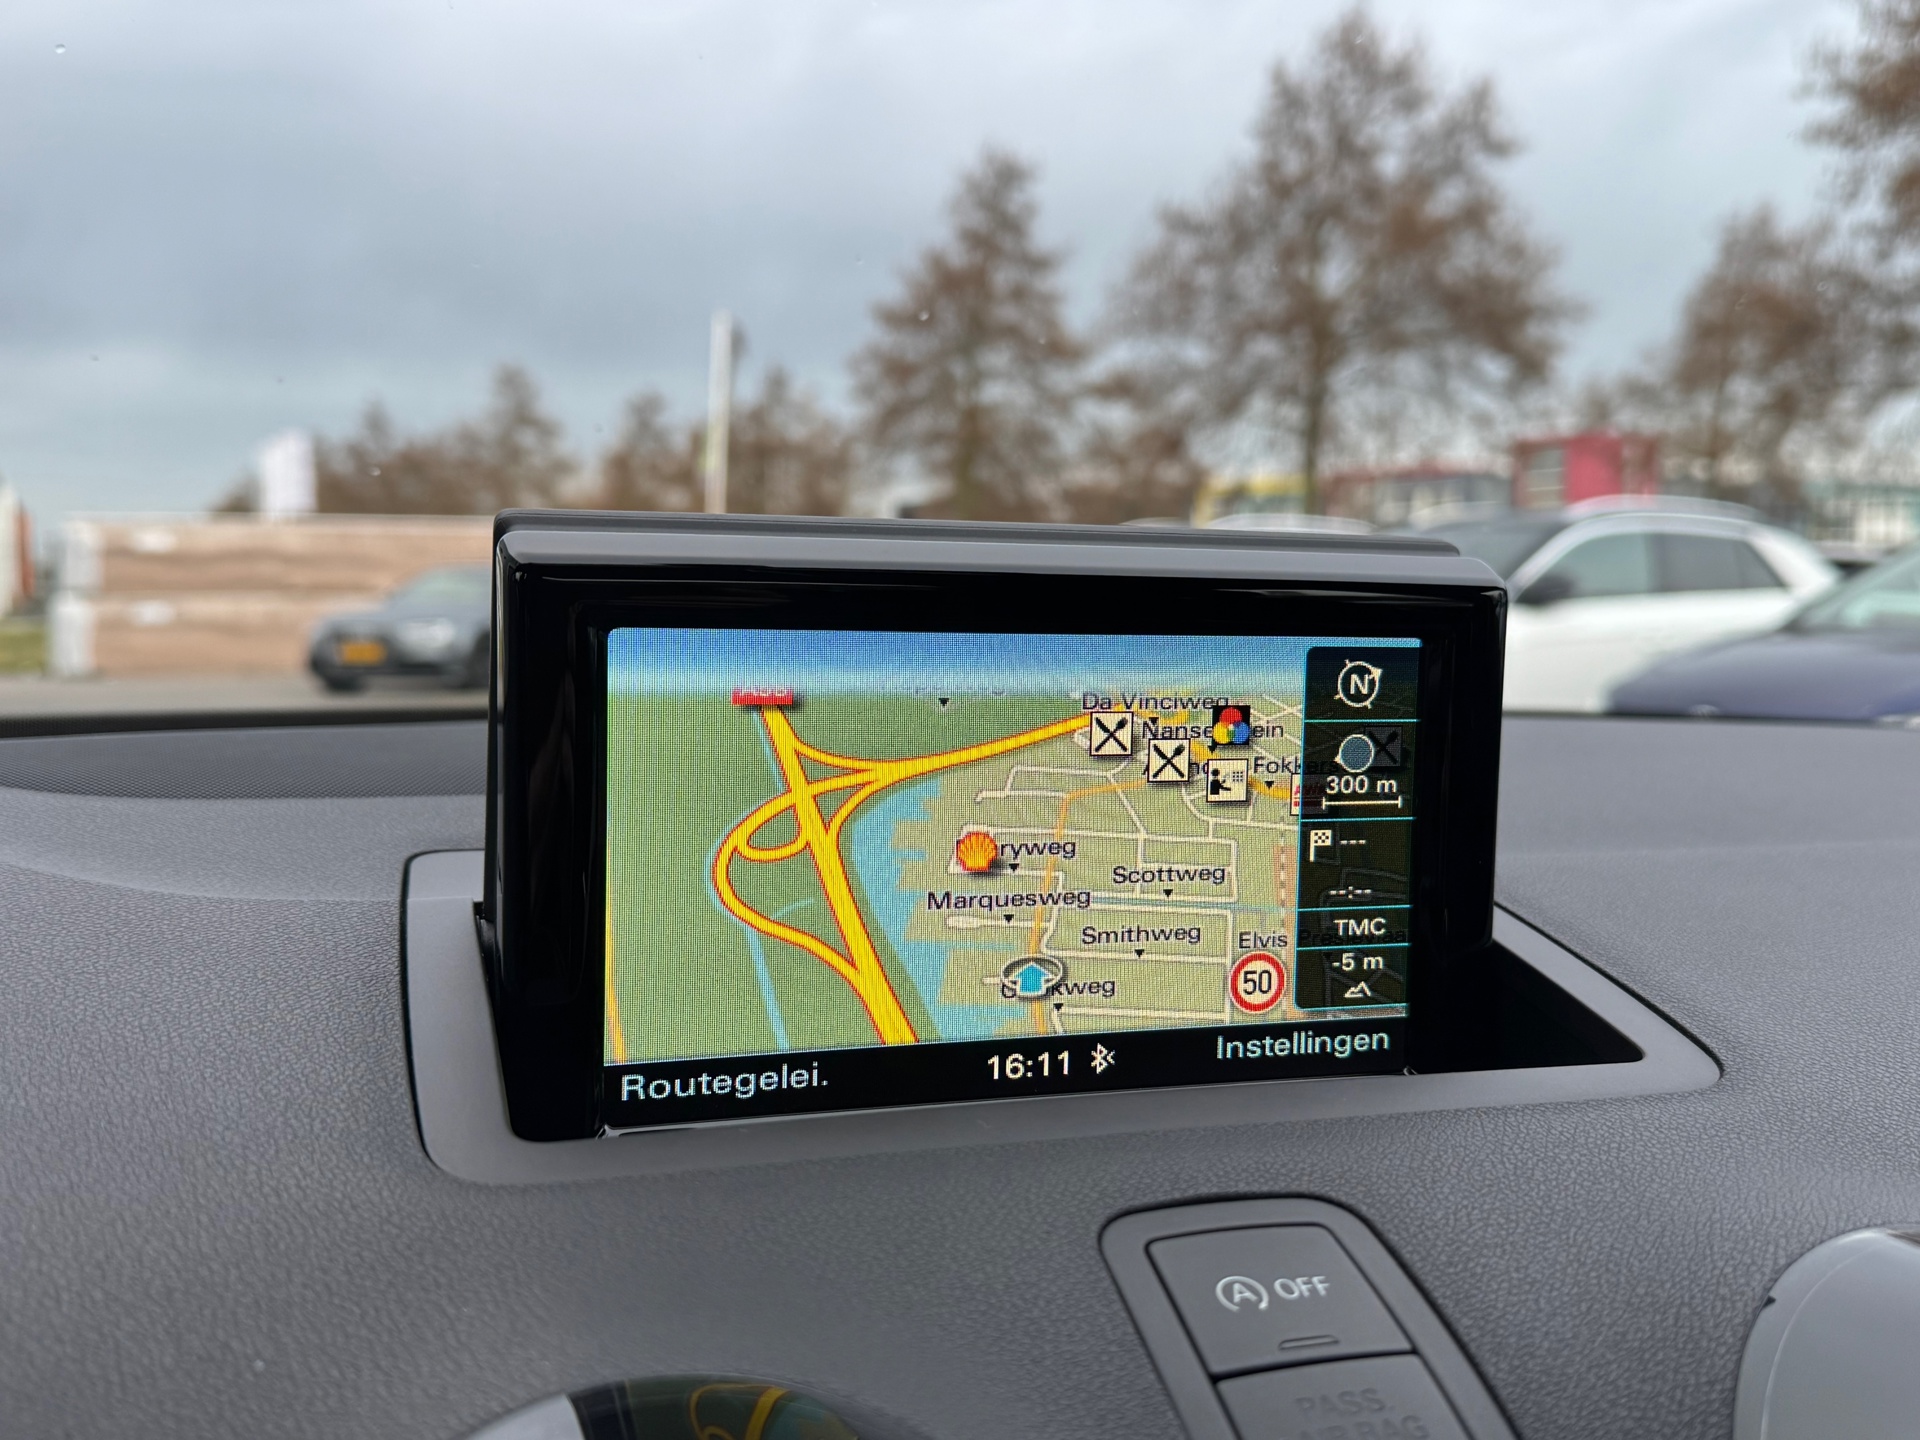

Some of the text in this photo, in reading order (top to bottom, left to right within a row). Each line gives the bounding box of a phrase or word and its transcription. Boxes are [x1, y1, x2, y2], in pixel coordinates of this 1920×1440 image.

[1083, 693, 1112, 710] Da
[1326, 775, 1398, 794] 300 m
[1113, 865, 1226, 884] Scottweg
[927, 891, 1091, 911] Marquesweg
[1082, 922, 1201, 945] Smithweg
[1333, 917, 1387, 936] TMC
[1238, 932, 1289, 949] Elvis
[1331, 953, 1384, 971] -5 m
[1243, 970, 1273, 995] 50
[1216, 1029, 1391, 1060] Instellingen
[987, 1050, 1071, 1080] 16:11
[621, 1061, 830, 1100] Routegelei.
[1273, 1275, 1330, 1300] OFF
